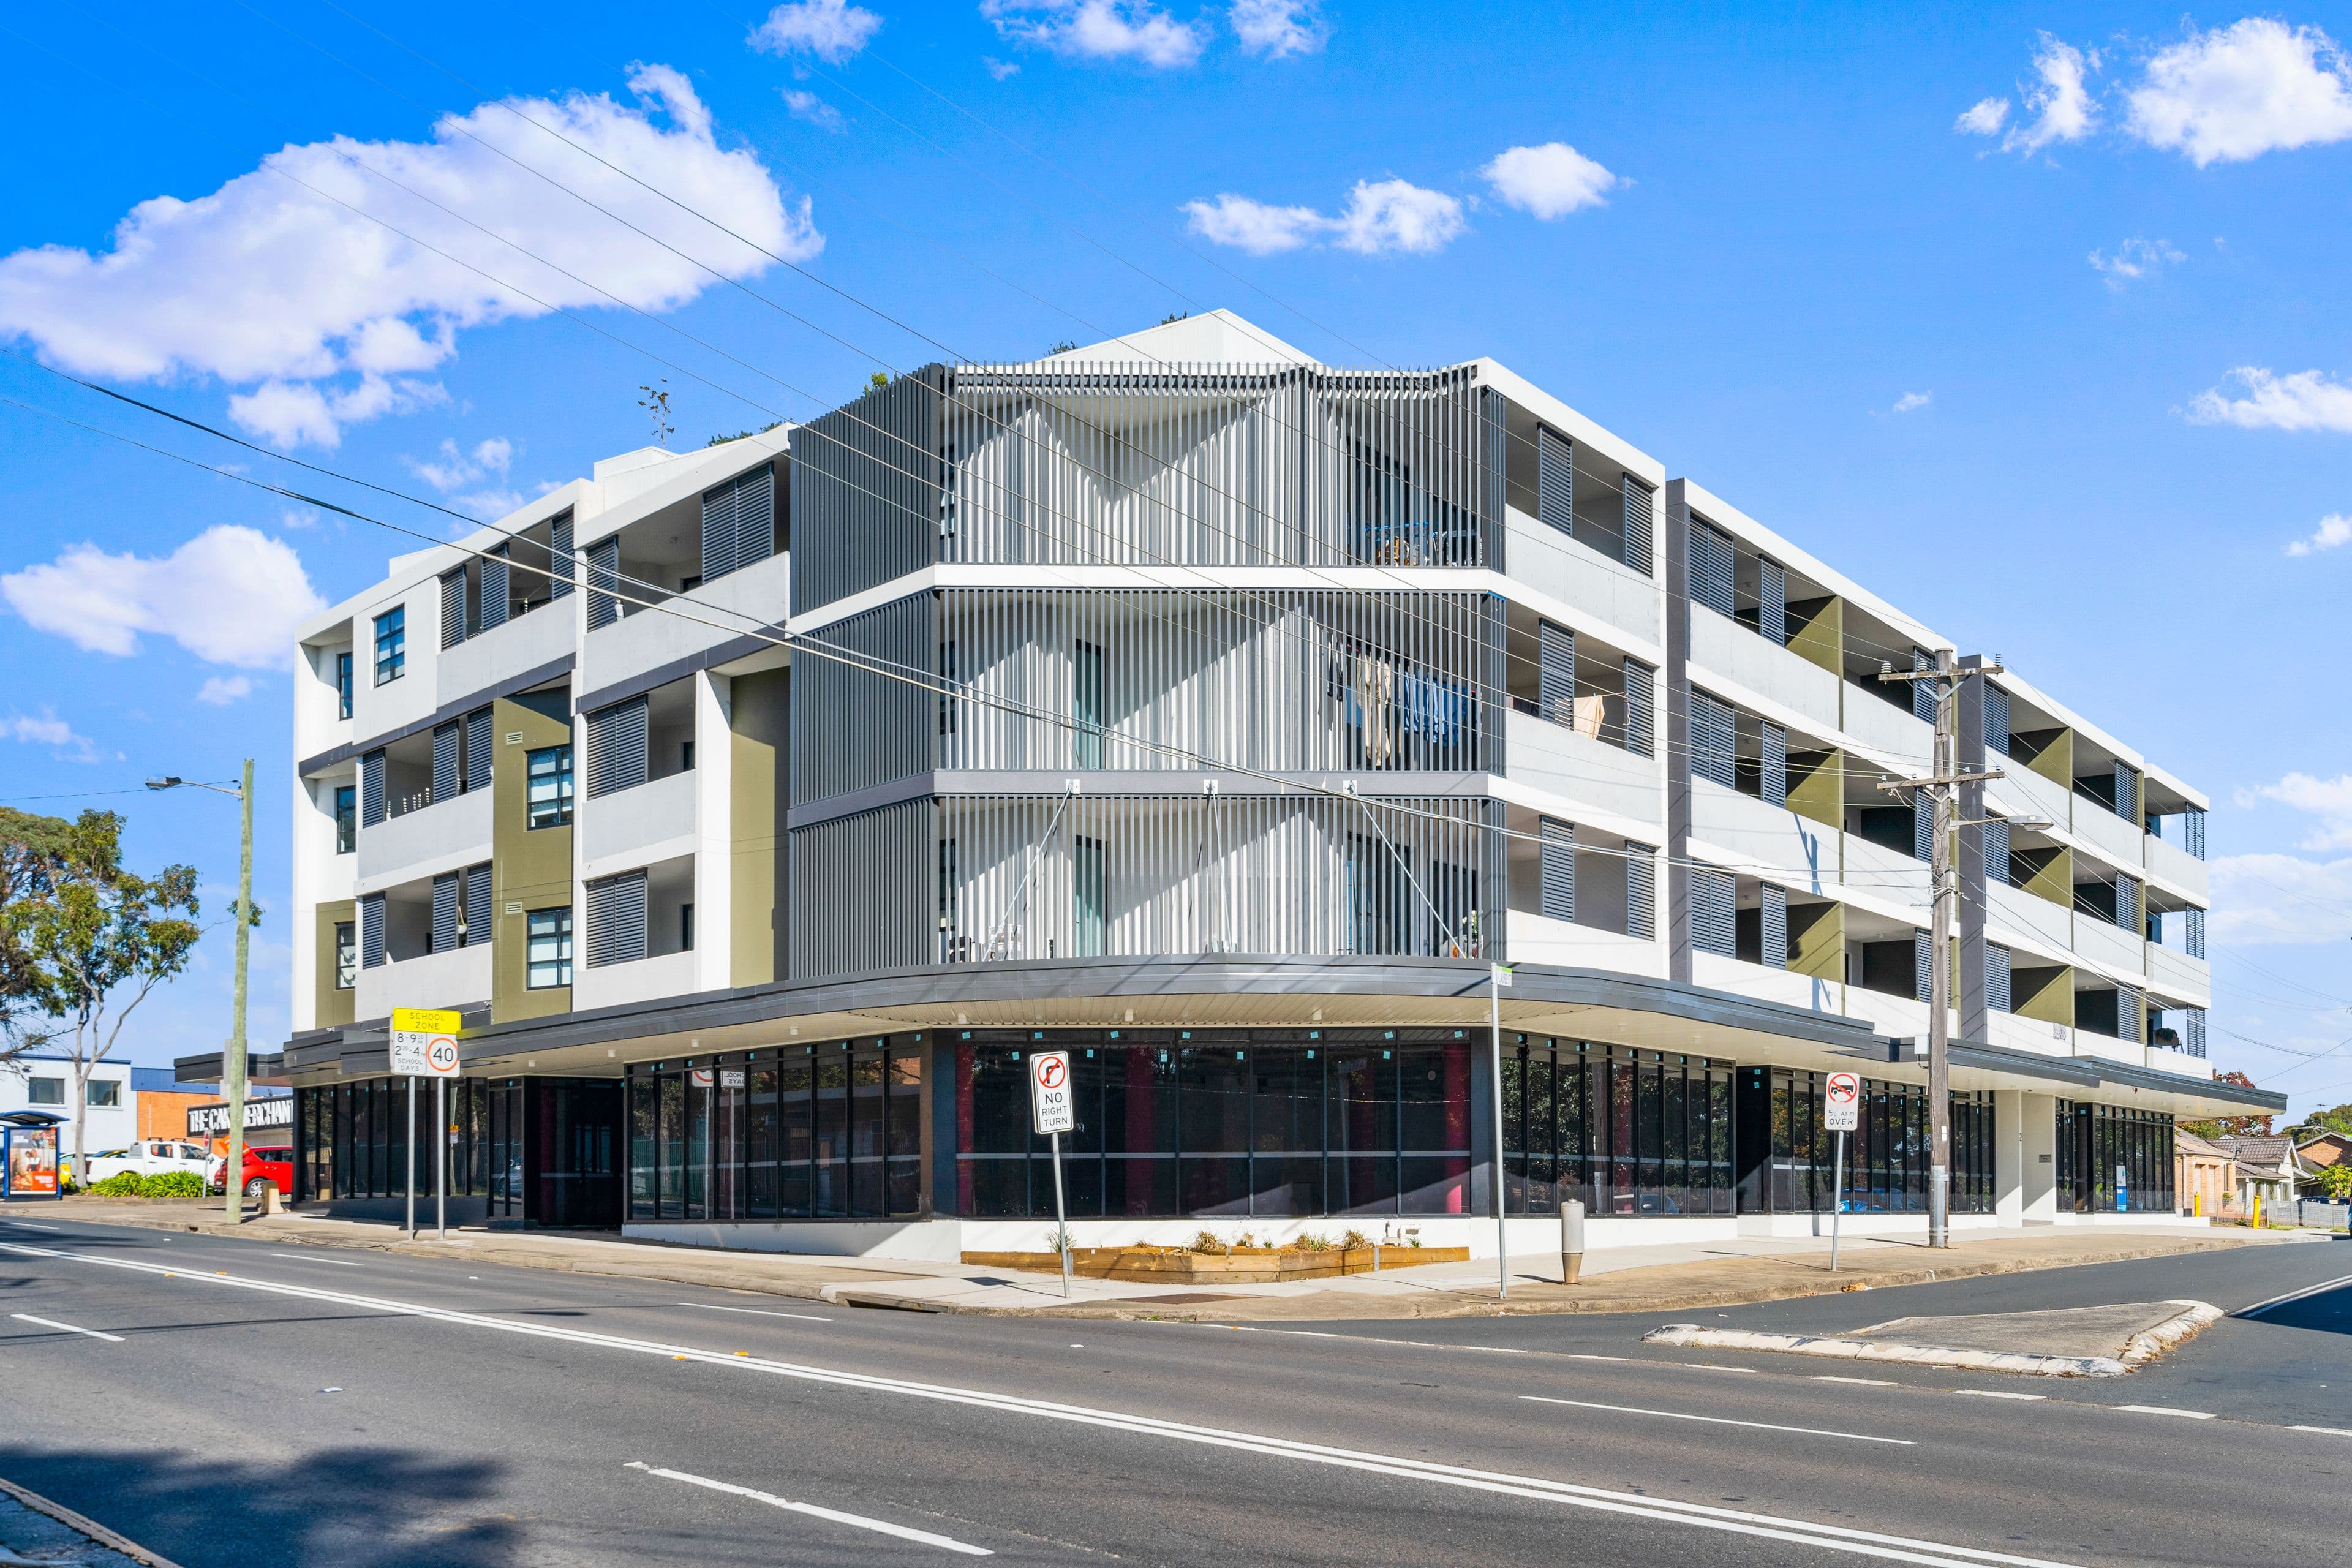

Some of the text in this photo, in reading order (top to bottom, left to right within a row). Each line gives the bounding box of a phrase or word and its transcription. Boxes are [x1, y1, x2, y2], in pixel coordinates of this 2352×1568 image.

[409, 1012, 446, 1021] SCHOOL
[432, 1047, 453, 1062] 40
[1045, 1092, 1063, 1104] NO
[188, 1099, 294, 1133] THE CAK ERCHANT
[1042, 1106, 1067, 1116] RIGHT
[1044, 1117, 1068, 1126] TURN
